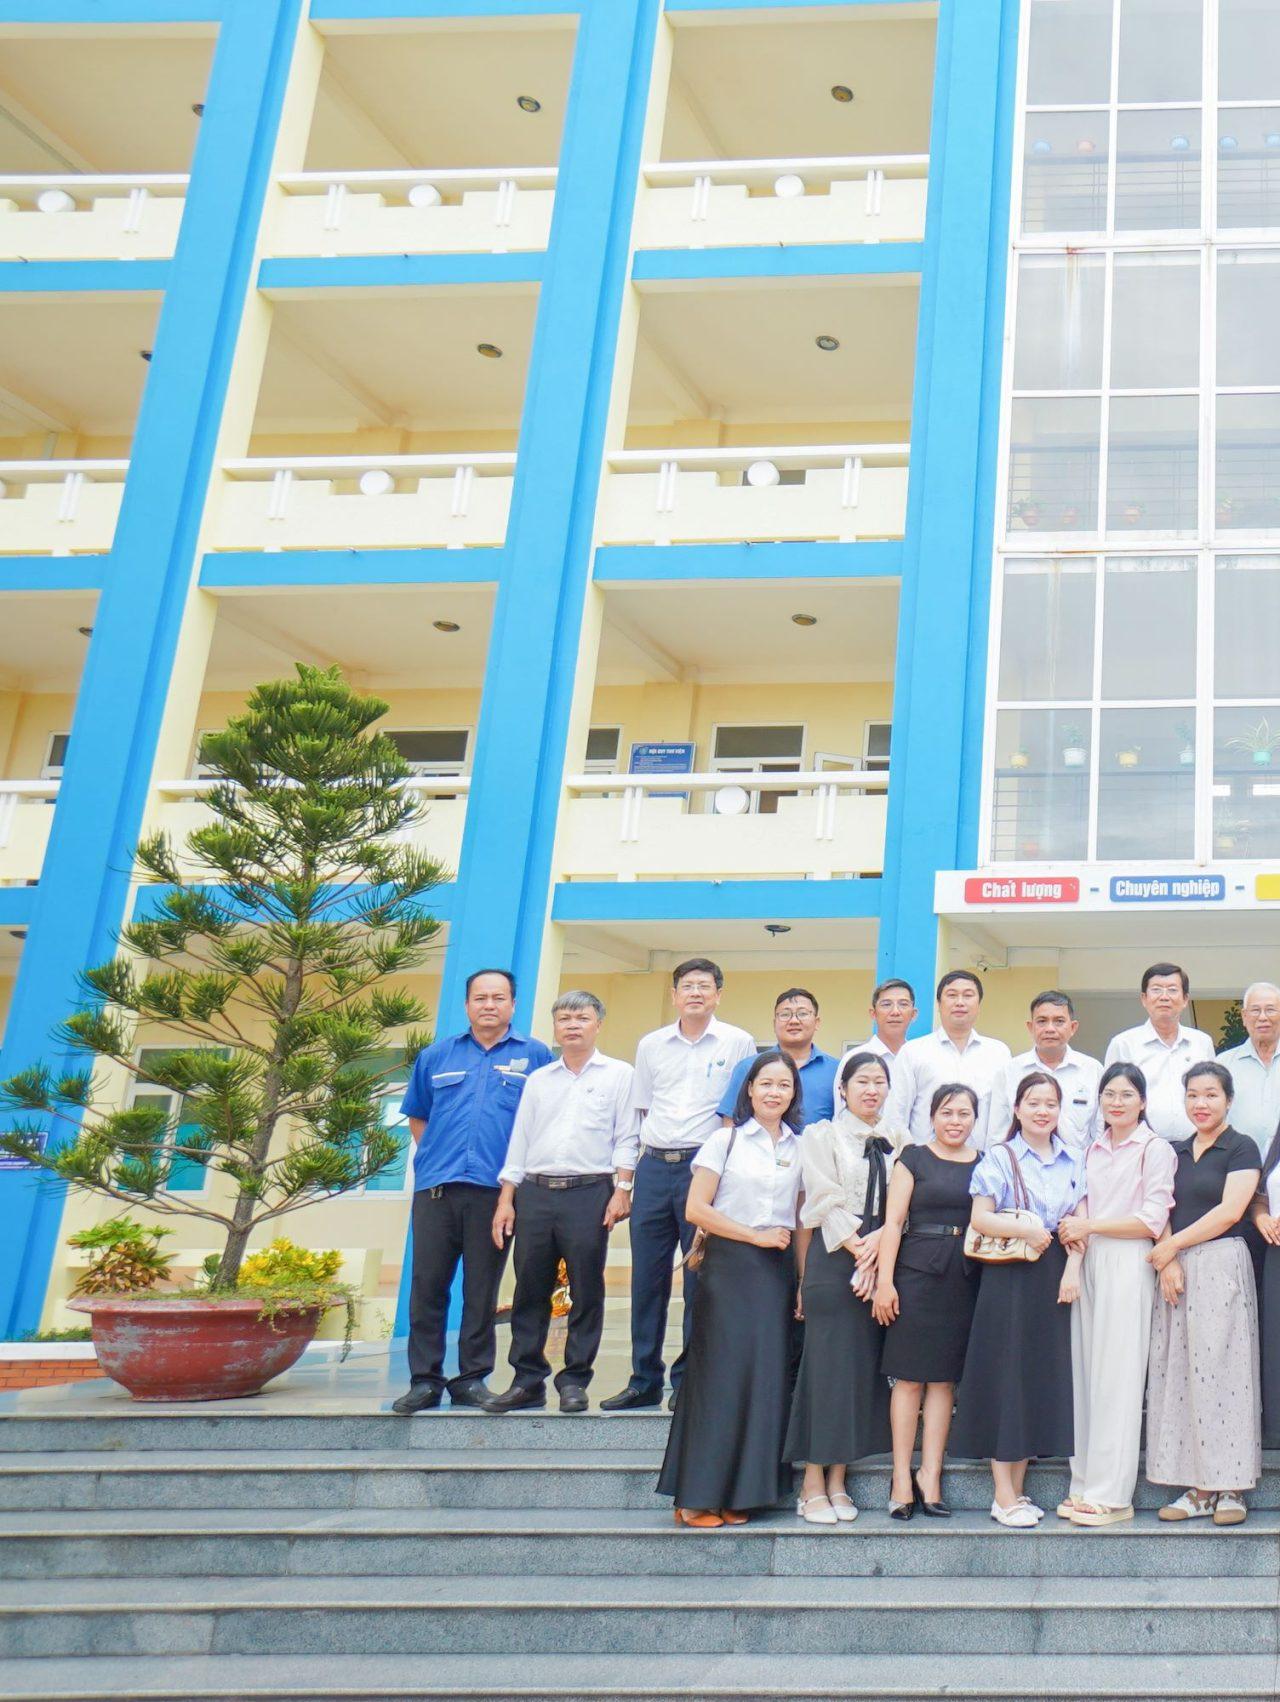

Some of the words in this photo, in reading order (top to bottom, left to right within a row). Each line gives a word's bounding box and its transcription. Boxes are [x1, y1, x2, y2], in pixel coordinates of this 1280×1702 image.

[1021, 881, 1062, 900] lượng
[1116, 880, 1168, 898] Chuyên
[1172, 879, 1220, 898] nghiệp
